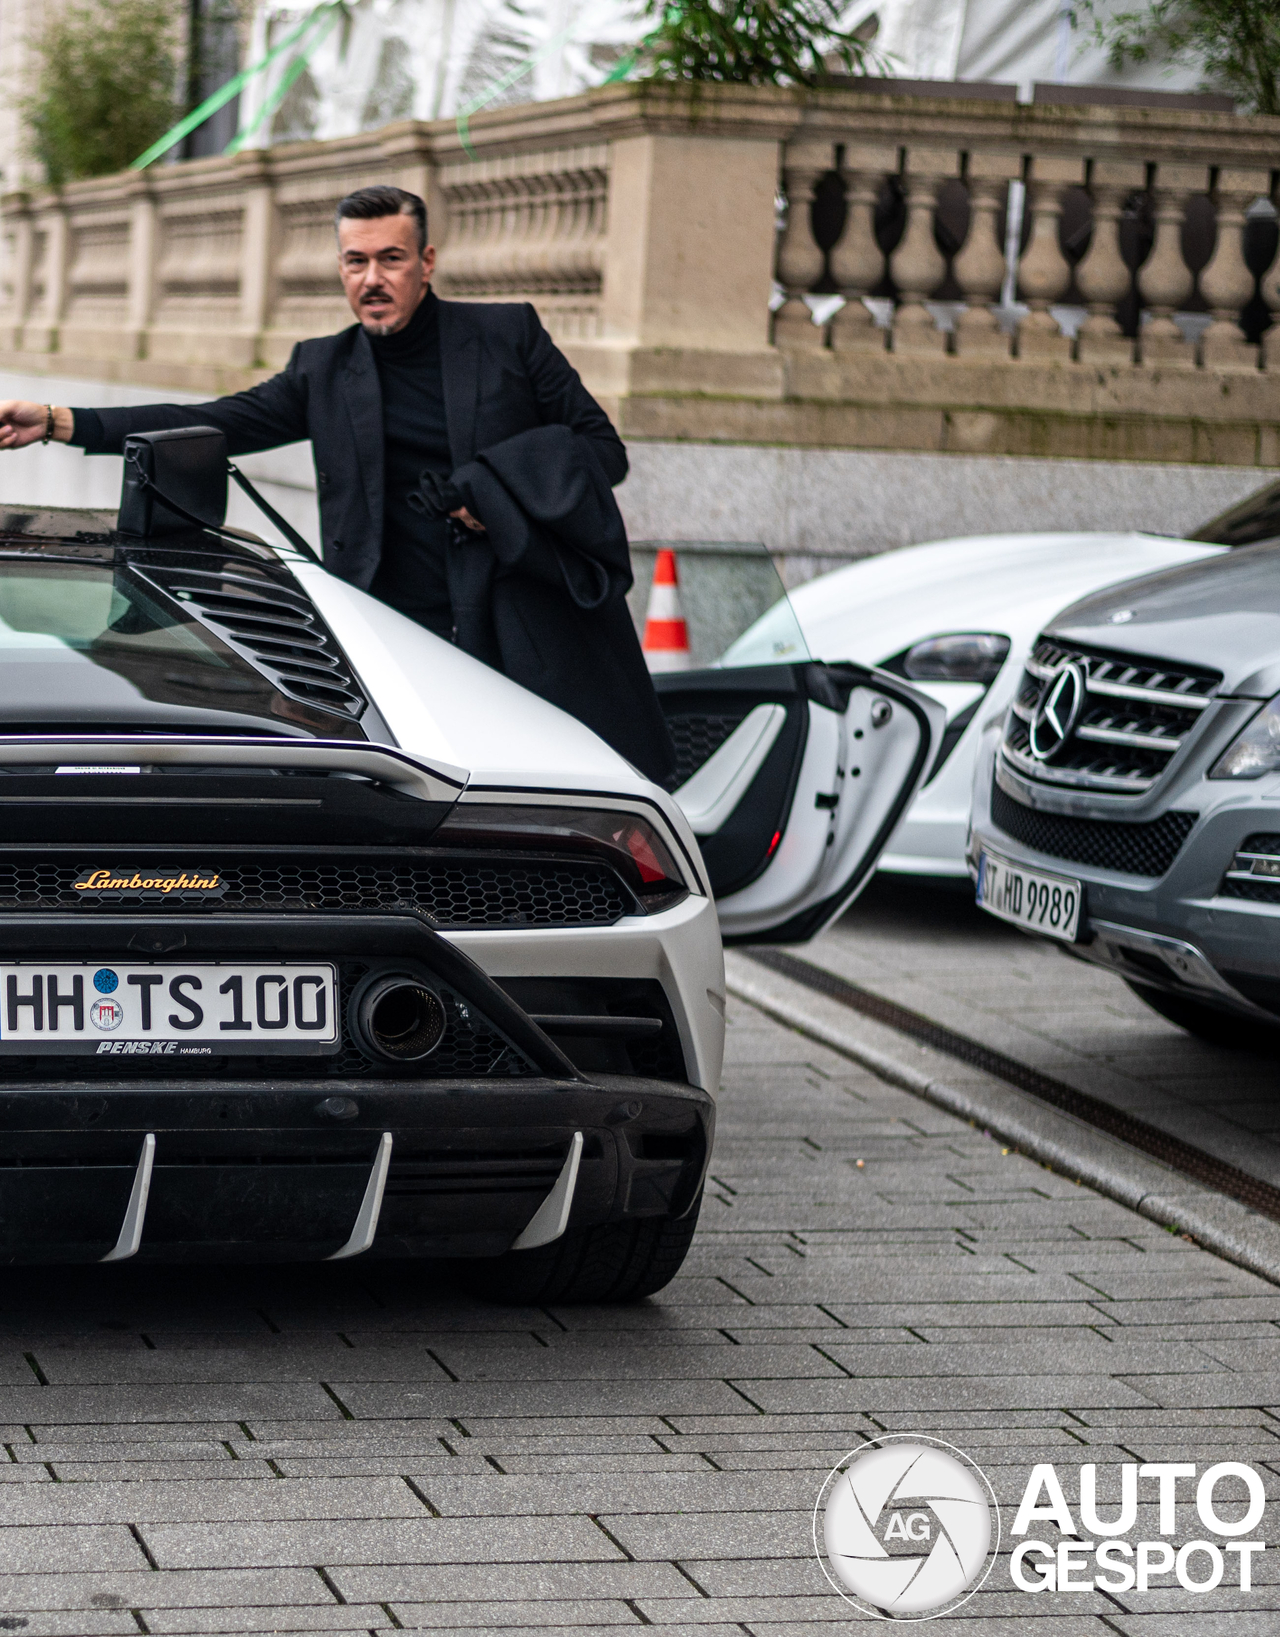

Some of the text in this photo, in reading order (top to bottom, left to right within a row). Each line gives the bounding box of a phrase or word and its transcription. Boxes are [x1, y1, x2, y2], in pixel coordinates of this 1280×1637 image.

[74, 870, 219, 893] Lamborghini
[1004, 869, 1023, 915] HD
[1027, 880, 1075, 931] 9989
[7, 974, 84, 1031] HH
[127, 974, 204, 1031] TS
[219, 974, 327, 1031] 100
[96, 1041, 212, 1055] PENSKE HAMBURG
